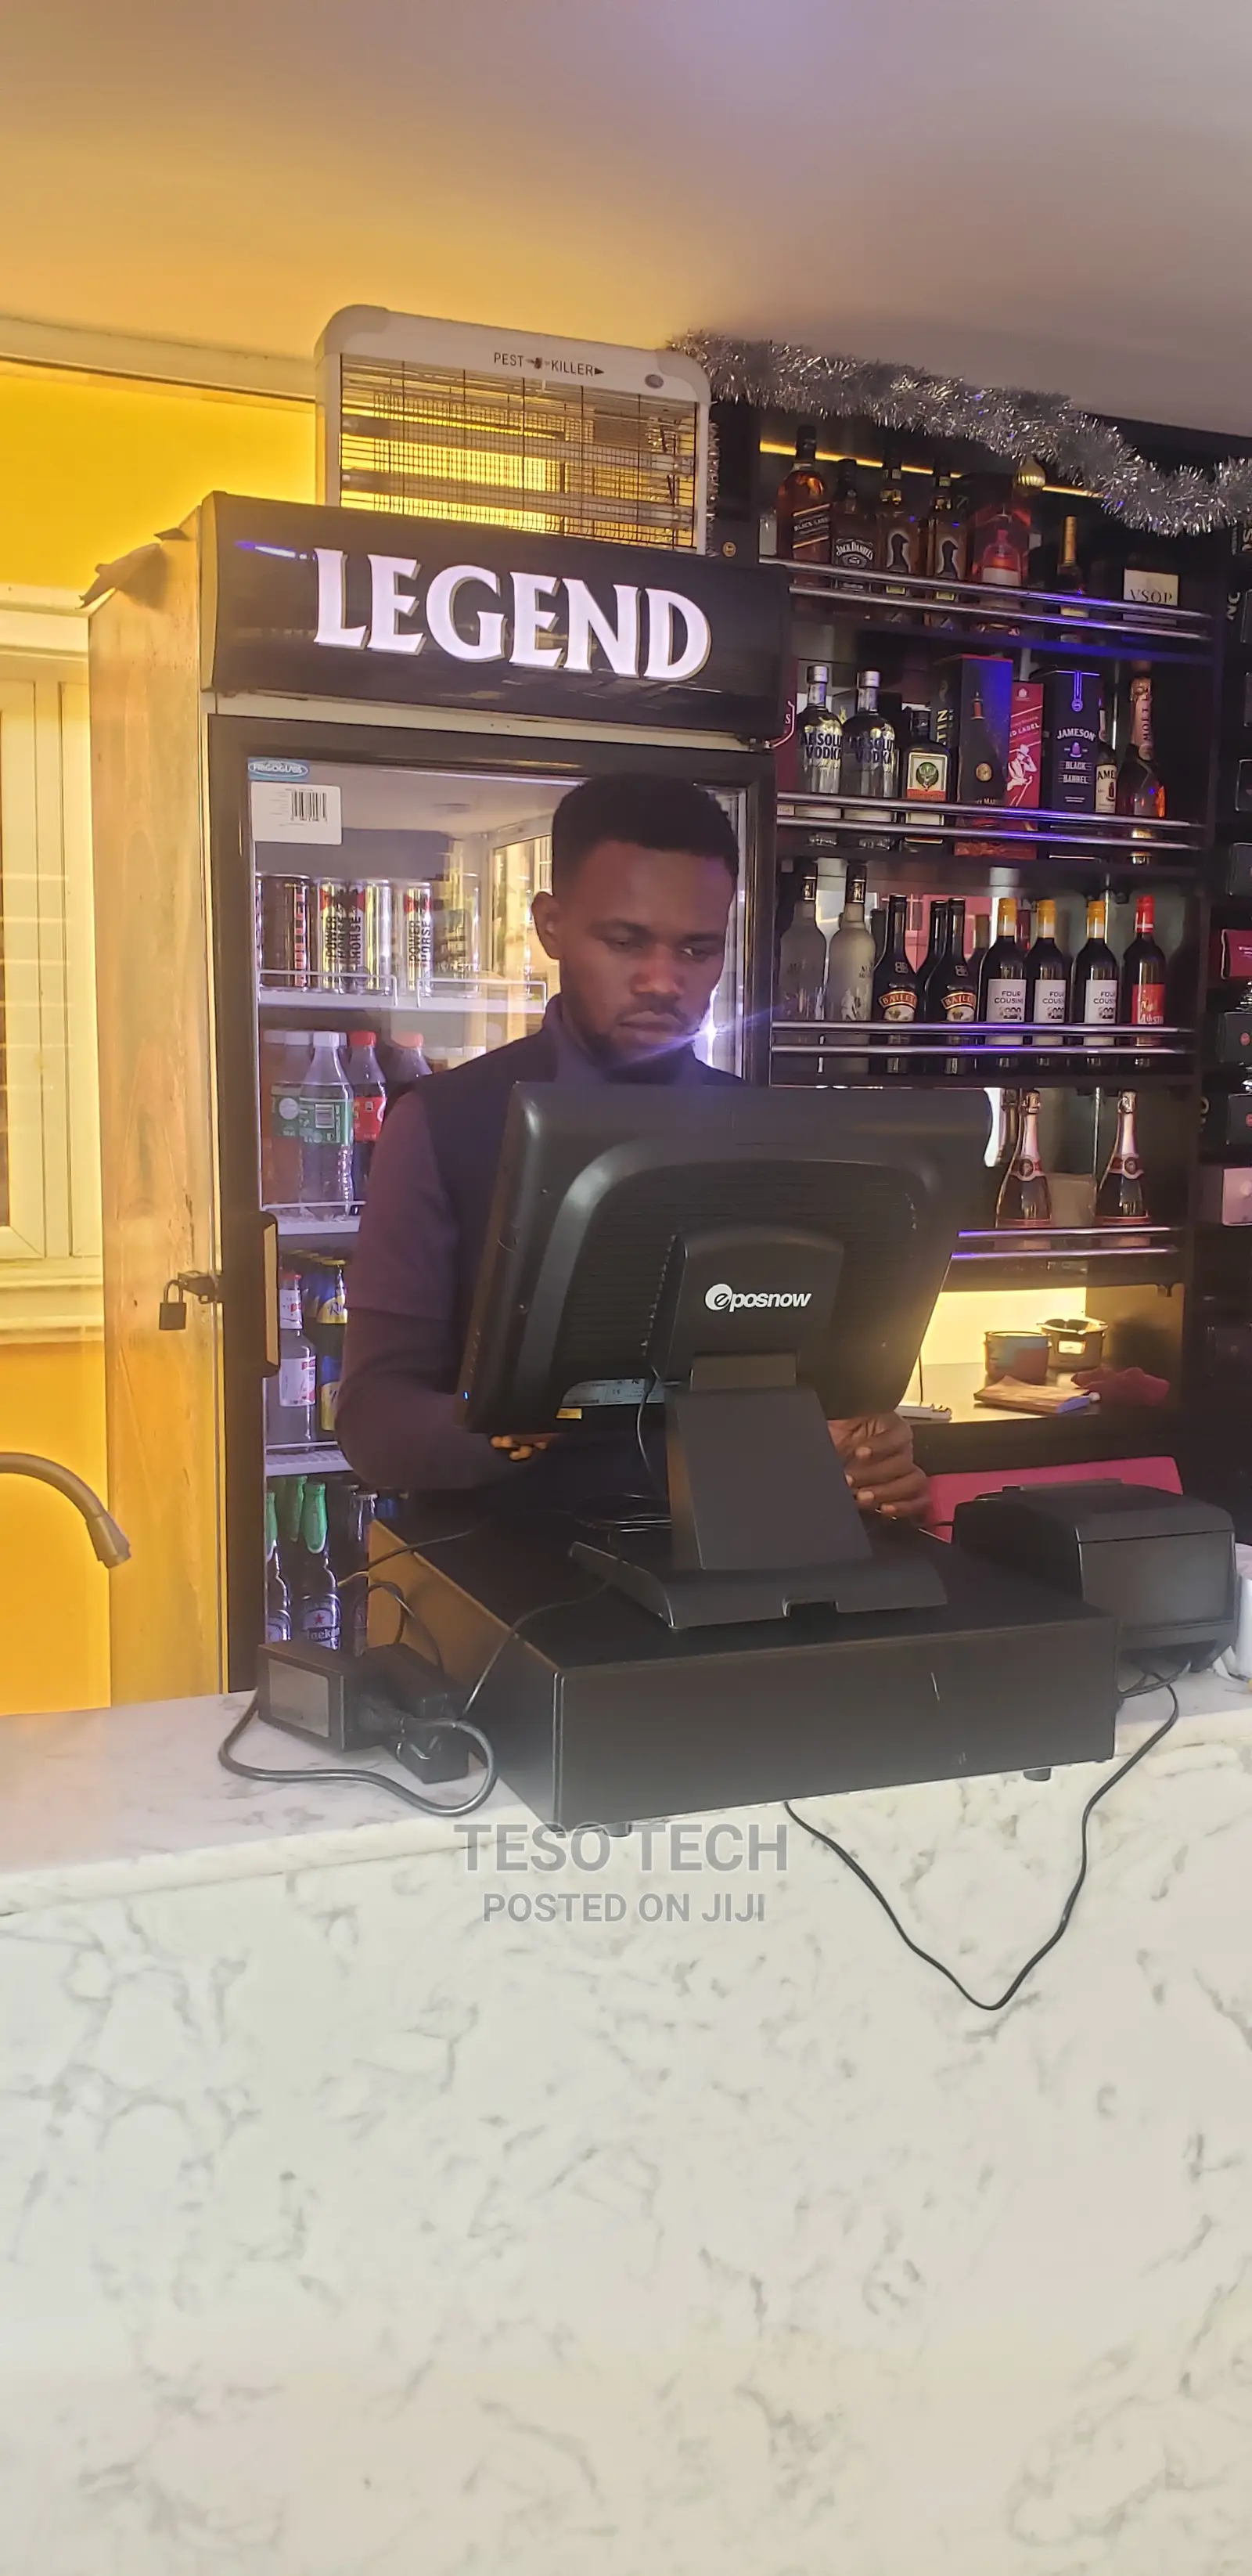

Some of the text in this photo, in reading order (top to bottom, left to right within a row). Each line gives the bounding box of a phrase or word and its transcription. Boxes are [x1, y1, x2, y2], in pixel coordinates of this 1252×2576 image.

[494, 352, 593, 376] PEST KILLER
[836, 543, 851, 557] JACK
[1129, 588, 1172, 604] VSOP
[313, 548, 712, 683] LEGEND
[936, 708, 948, 745] TIN
[1056, 728, 1096, 742] JAMESON
[800, 732, 842, 748] ABSOLU
[325, 917, 336, 958] POWER
[408, 921, 420, 961] POWER
[882, 993, 916, 1005] BAILEY
[705, 1283, 811, 1313] eposnow
